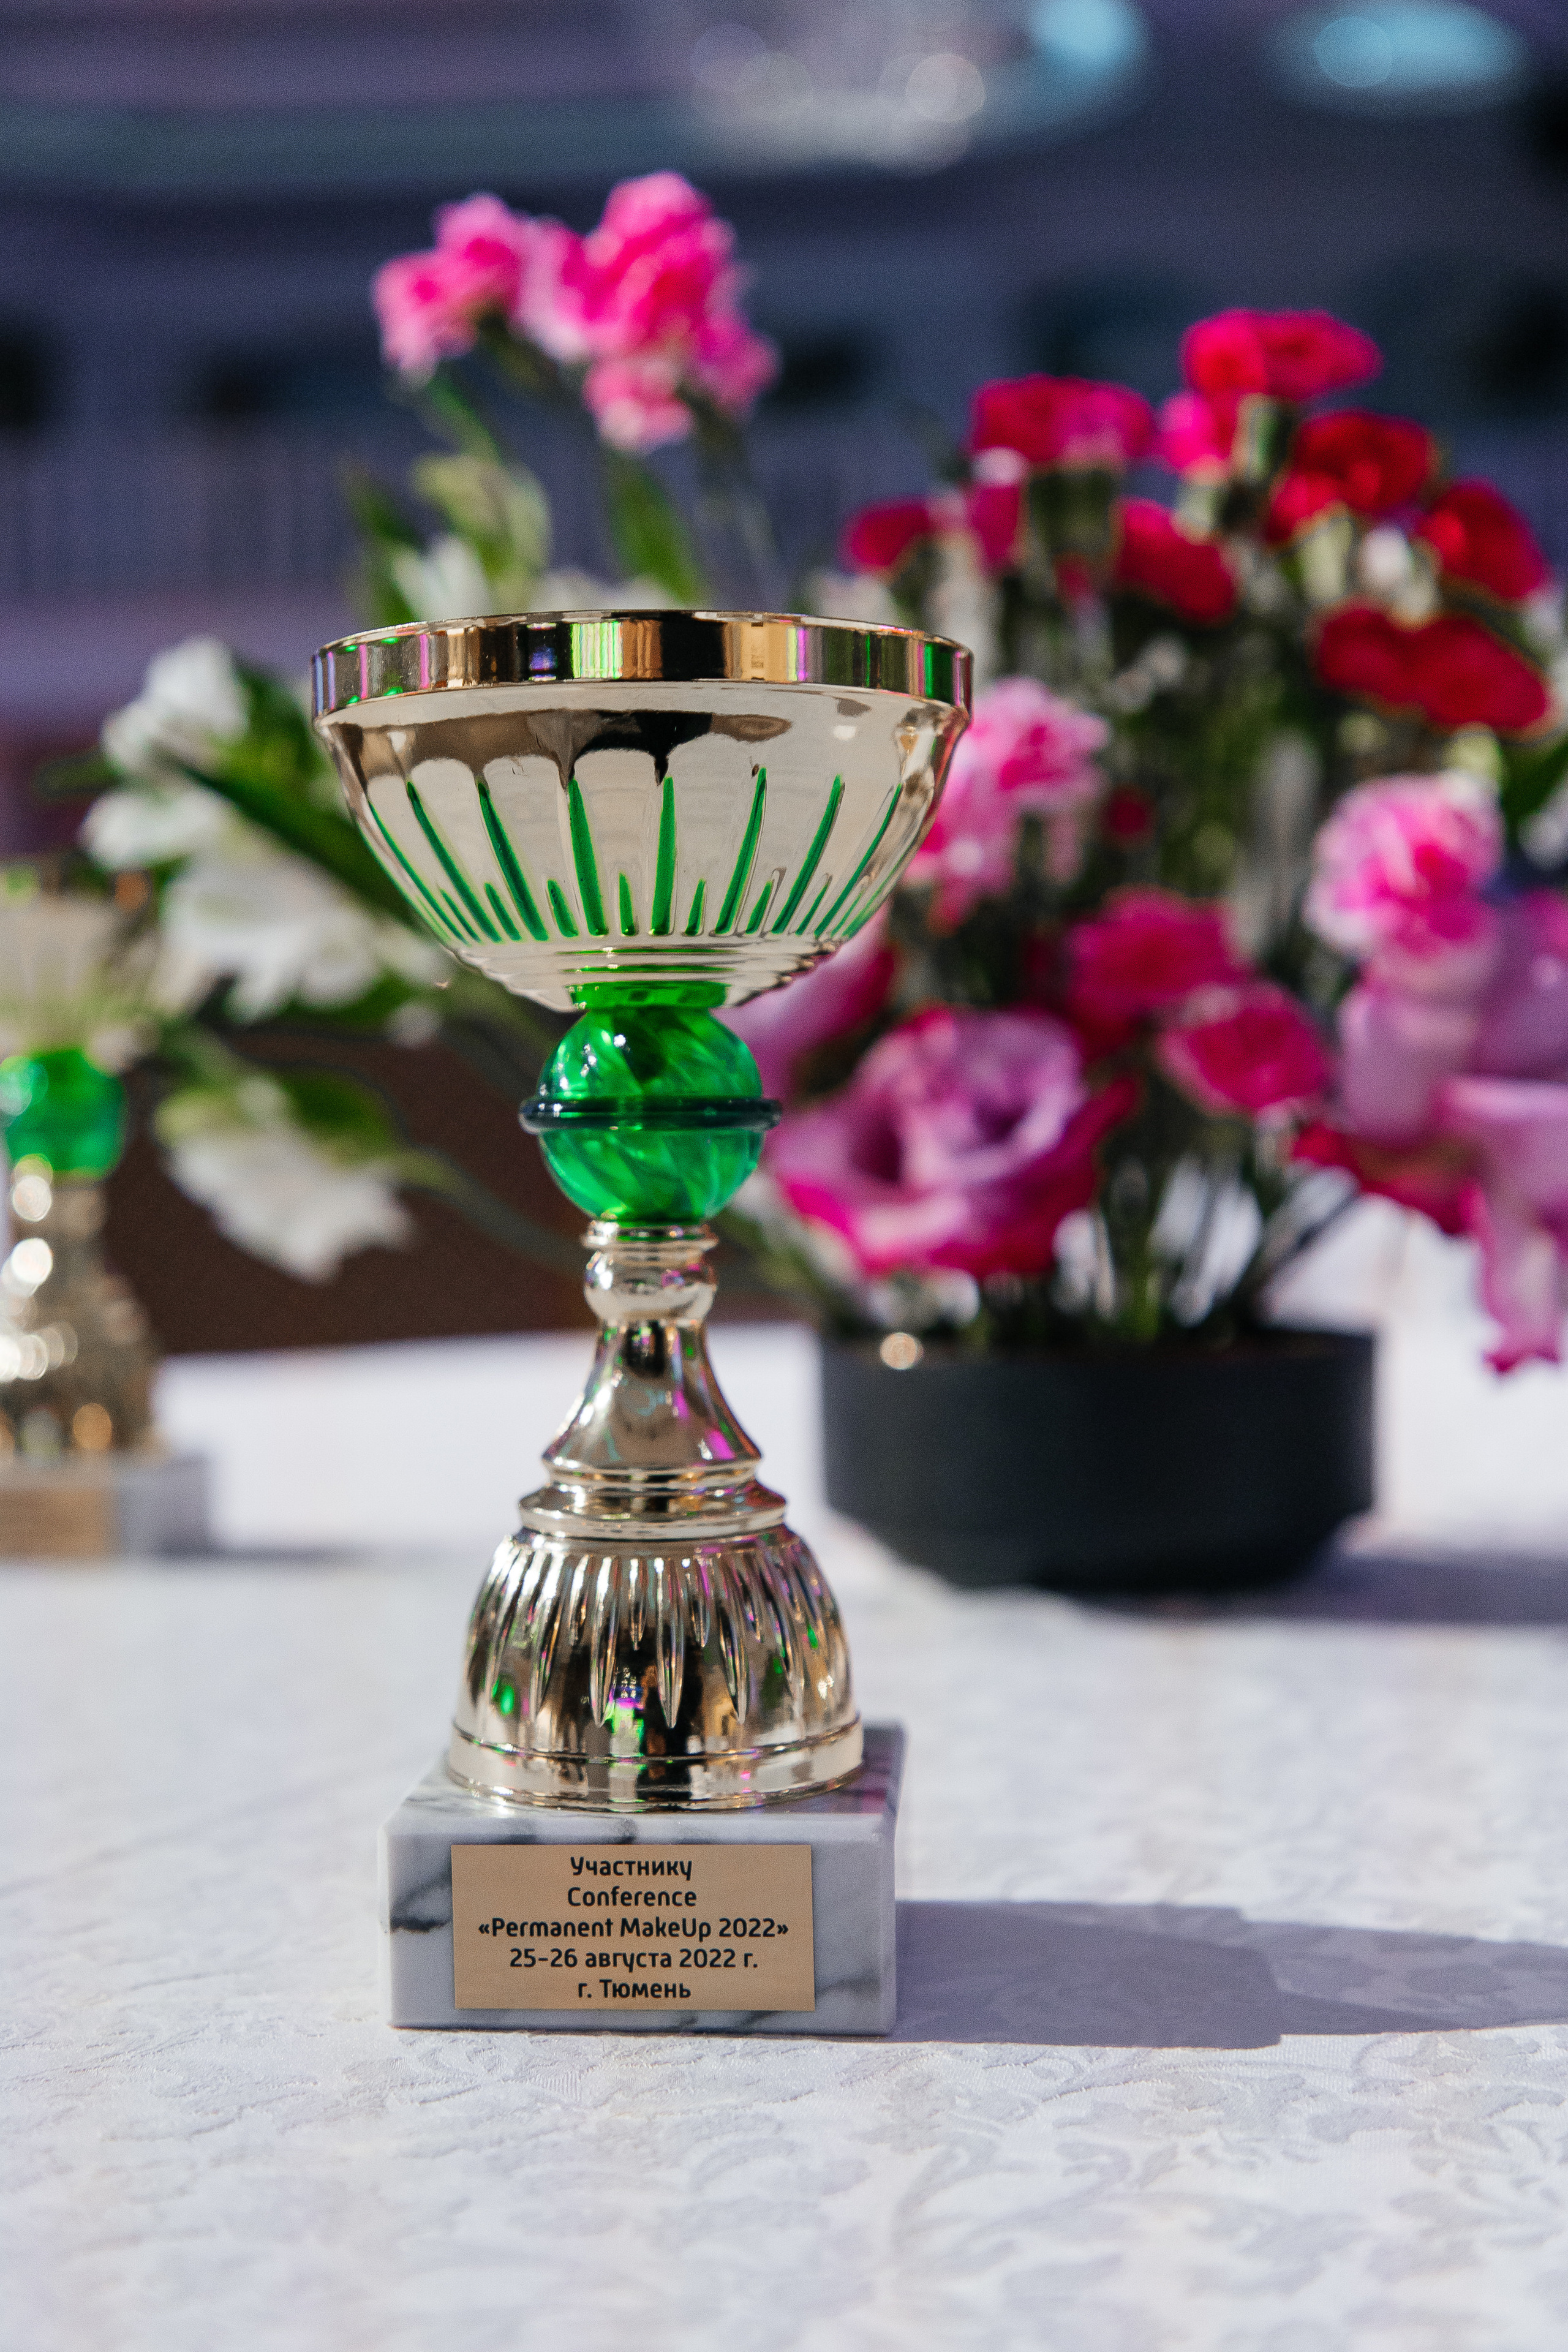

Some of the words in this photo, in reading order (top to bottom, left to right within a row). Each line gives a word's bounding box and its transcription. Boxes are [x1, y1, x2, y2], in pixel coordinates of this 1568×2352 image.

[570, 1856, 692, 1882] Участнику
[567, 1885, 697, 1907] Conference
[478, 1917, 614, 1937] «Permanent
[620, 1916, 712, 1943] MakeUp
[718, 1917, 789, 1938] 2022»
[585, 1952, 672, 1973] августа
[679, 1948, 736, 1969] 2022
[744, 1953, 758, 1969] г.
[578, 1983, 592, 1999] г.
[598, 1978, 692, 1999] Тюмень
